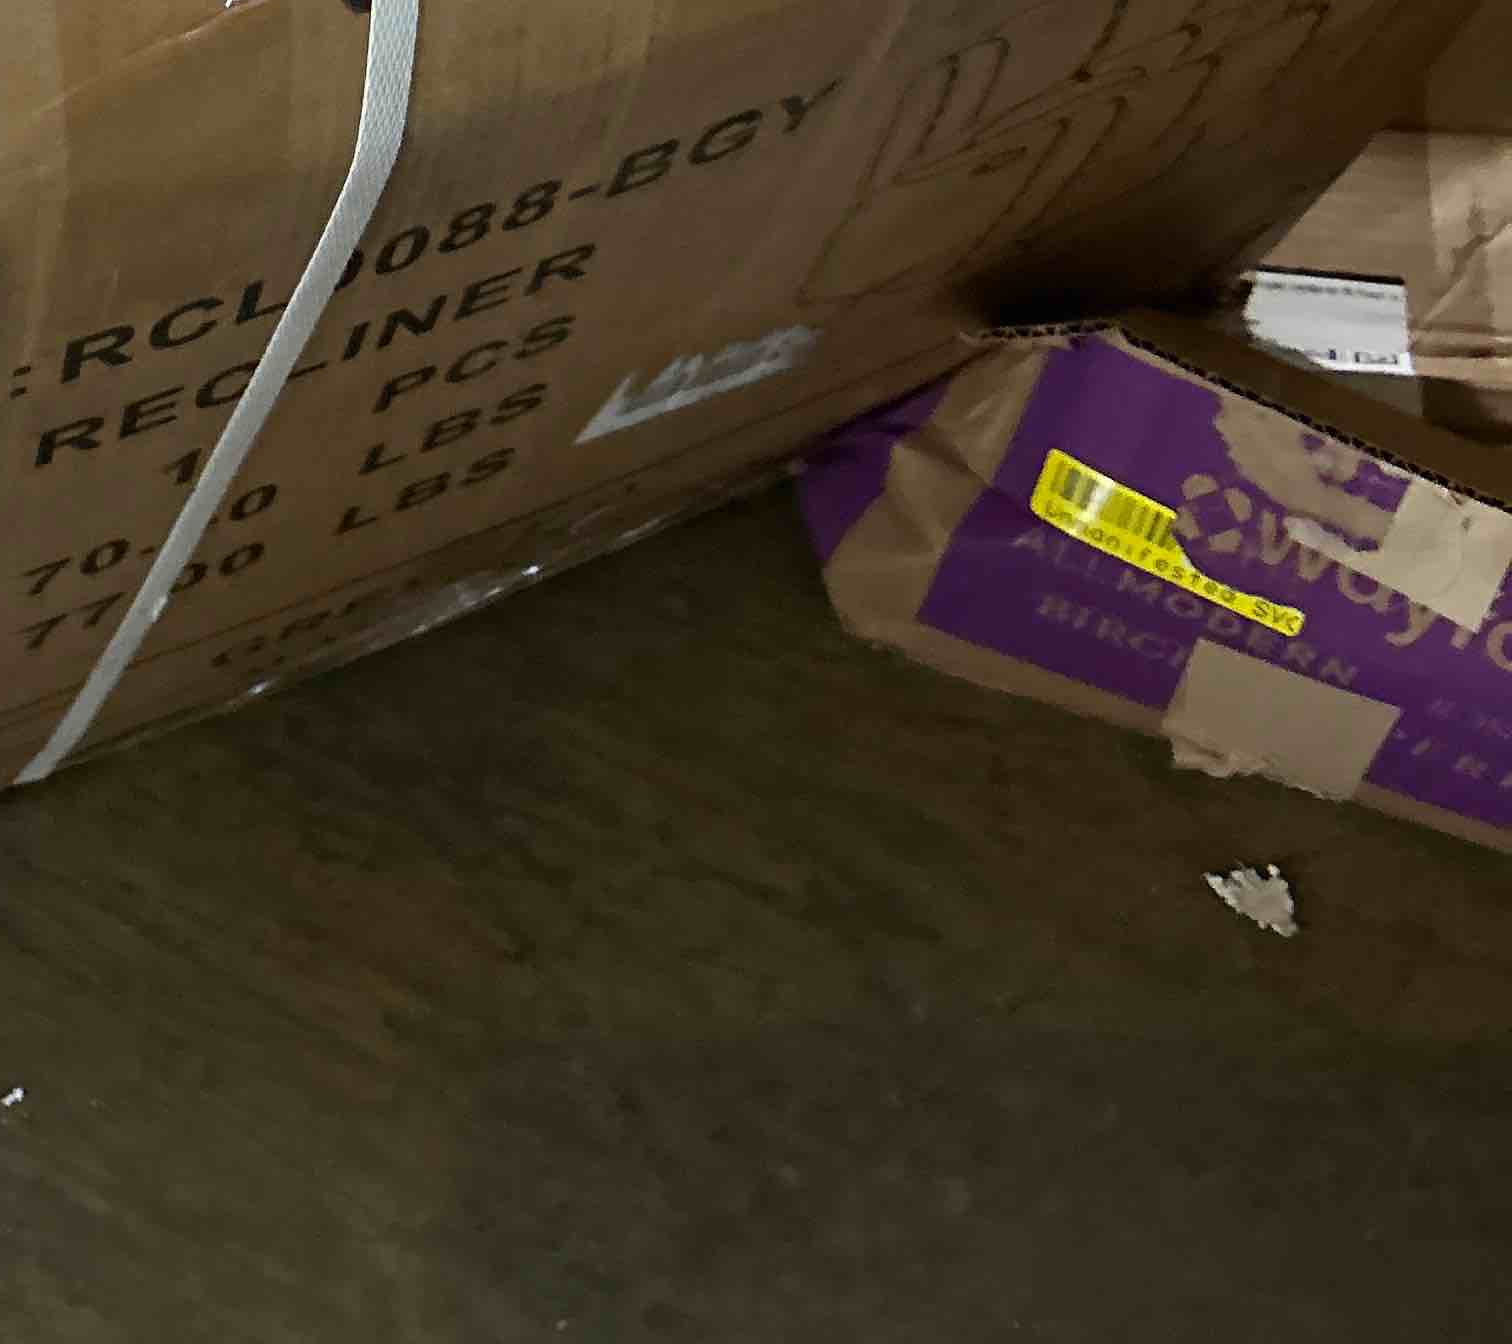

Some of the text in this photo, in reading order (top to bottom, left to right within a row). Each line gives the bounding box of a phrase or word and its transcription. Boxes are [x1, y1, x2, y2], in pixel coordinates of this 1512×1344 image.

[373, 314, 576, 413] PCS
[358, 382, 549, 477] LBS
[331, 446, 518, 537] LBS
